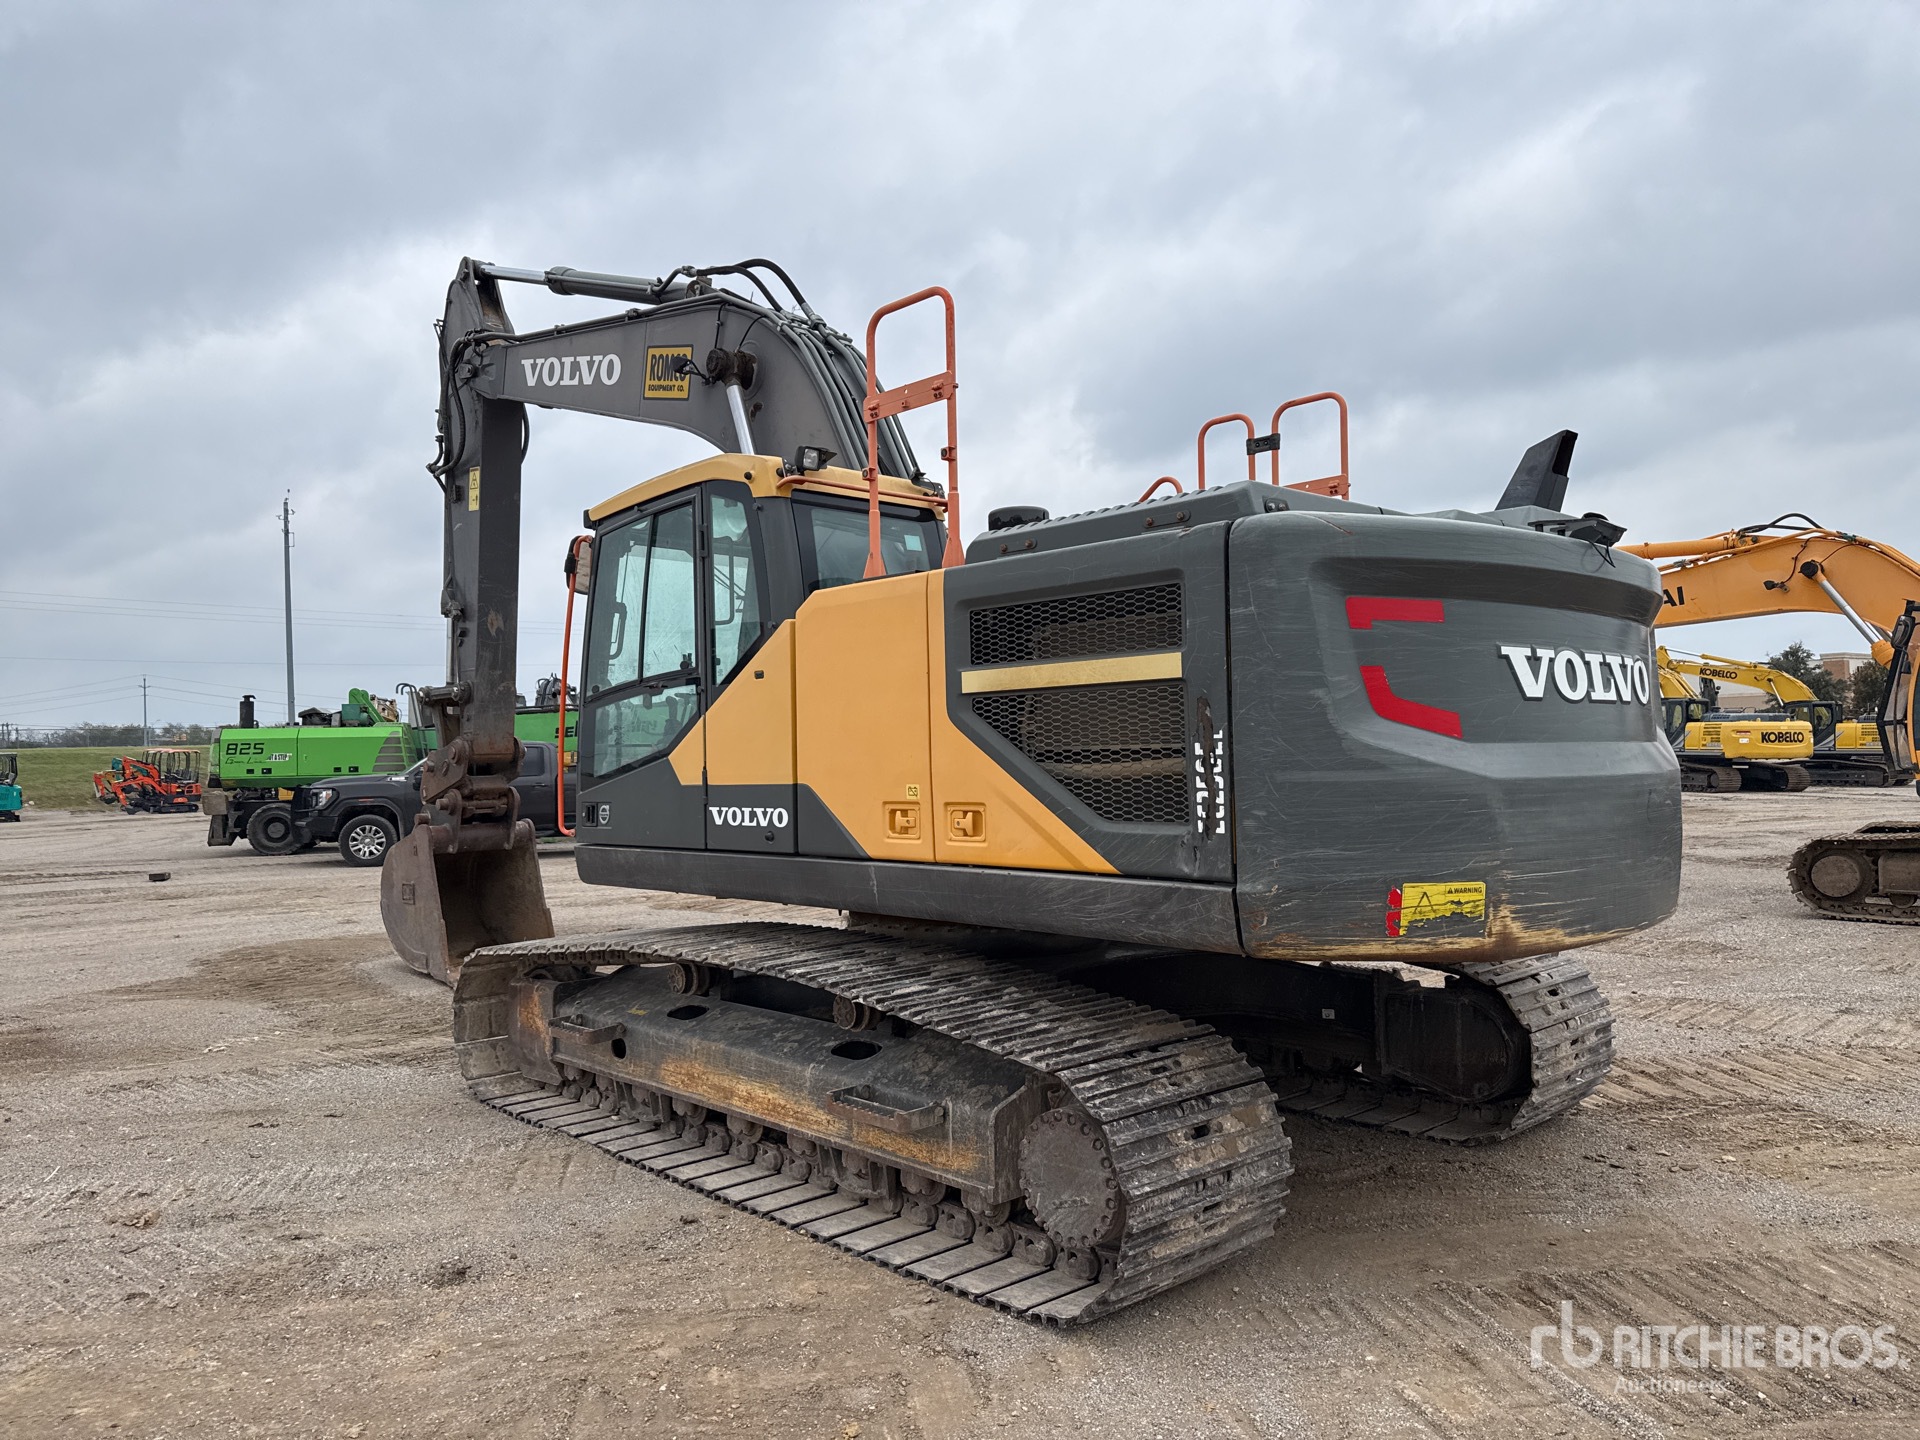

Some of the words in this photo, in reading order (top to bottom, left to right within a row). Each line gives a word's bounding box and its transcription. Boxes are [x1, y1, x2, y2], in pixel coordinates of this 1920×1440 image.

[521, 353, 622, 387] VOLVO
[648, 384, 676, 392] EQUIPMENT
[1498, 643, 1650, 705] VOLVO
[1699, 667, 1738, 680] KOBELCO
[1761, 731, 1805, 743] KOBELCO
[226, 742, 265, 755] 825
[708, 806, 789, 828] VOLVO
[1453, 886, 1483, 894] WARNING
